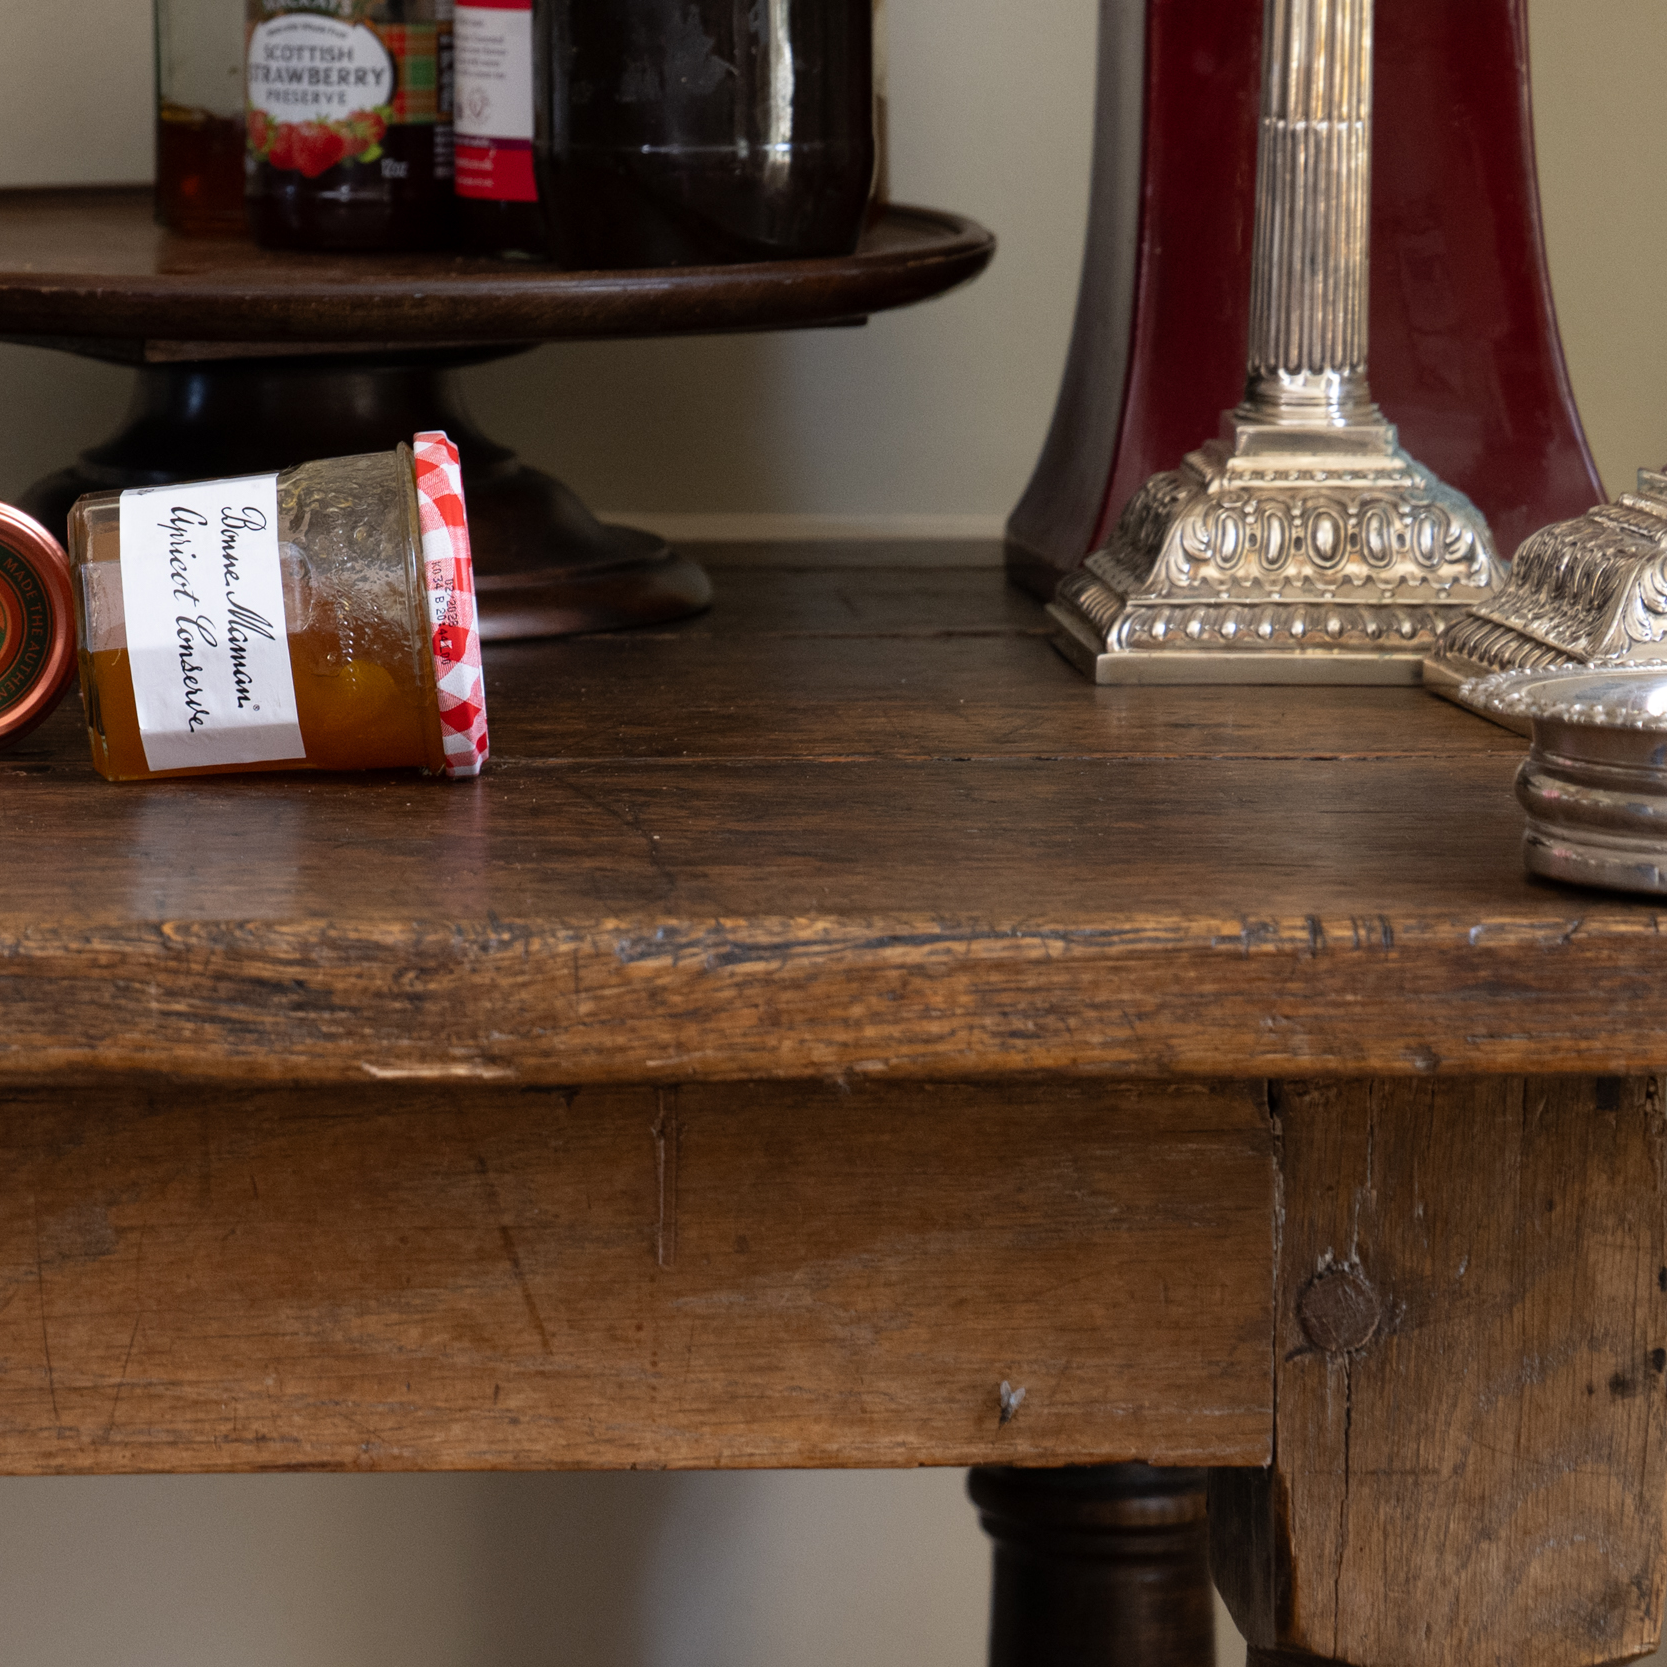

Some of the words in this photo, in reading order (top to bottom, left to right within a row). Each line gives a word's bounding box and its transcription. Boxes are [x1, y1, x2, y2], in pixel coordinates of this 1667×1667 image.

[264, 44, 354, 62] SCOTTISH
[266, 88, 347, 105] PRESERVE
[157, 506, 208, 607] Apricot
[221, 506, 267, 587] Bonne
[3, 557, 39, 600] MADE
[29, 601, 44, 637] THE
[434, 596, 445, 604] B
[176, 614, 218, 733] Conserve
